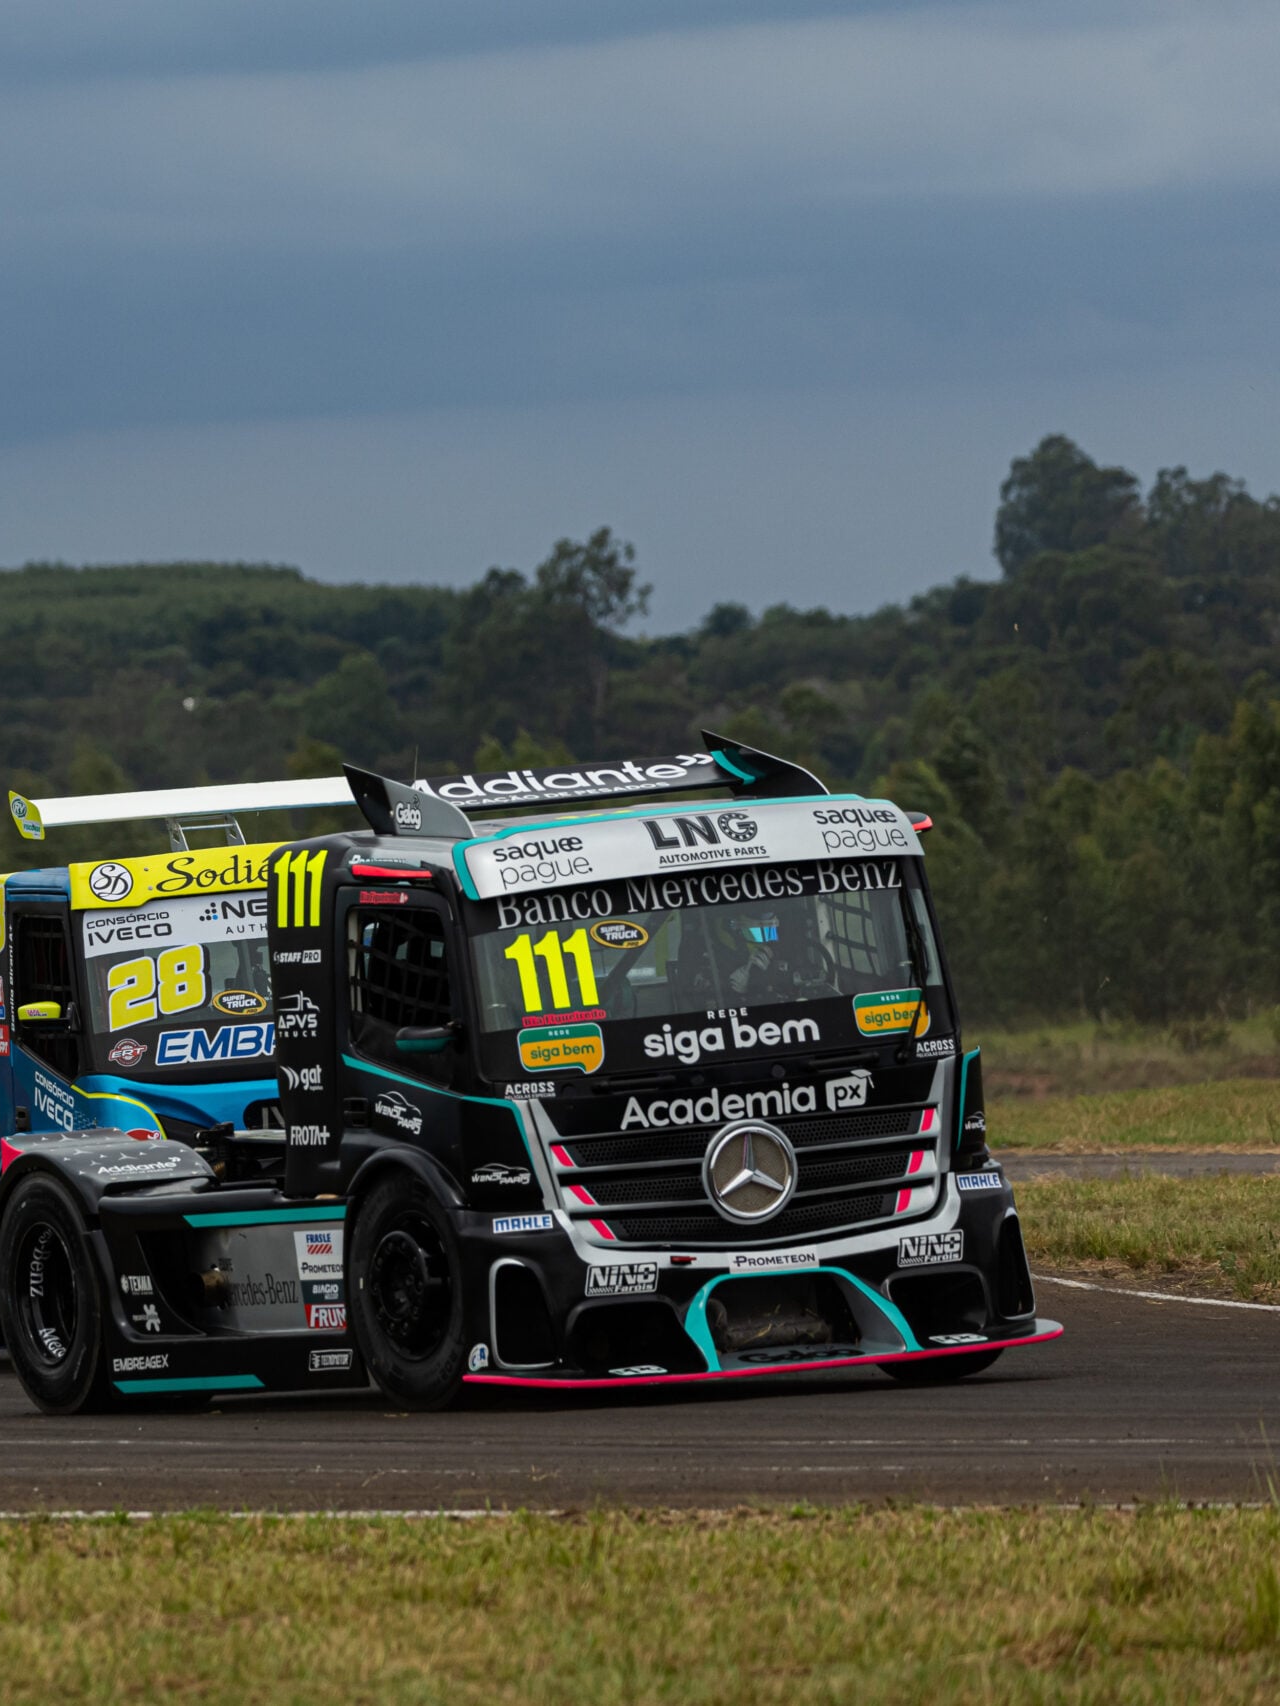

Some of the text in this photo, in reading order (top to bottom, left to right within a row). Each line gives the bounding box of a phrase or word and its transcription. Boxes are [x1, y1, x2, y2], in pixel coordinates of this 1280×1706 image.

[642, 812, 758, 851] LNG
[658, 845, 768, 865] AUTOMOTIVE PARTS
[273, 849, 329, 928] 111
[496, 858, 903, 931] Banco Mercedes-Benz
[85, 910, 170, 930] CONSÓRCIO
[87, 922, 173, 946] IVECO
[605, 930, 639, 941] TRUCK
[504, 928, 600, 1013] 111
[107, 943, 206, 1033] 28
[221, 993, 246, 1003] SUPER
[226, 998, 258, 1009] TRUCK
[707, 1006, 749, 1020] REDE
[277, 1013, 318, 1029] APVS
[863, 1008, 891, 1028] siga
[278, 1030, 317, 1038] TRUCK
[643, 1016, 821, 1065] siga bem
[530, 1043, 595, 1062] siga bem
[915, 1038, 955, 1054] ACROSS
[504, 1081, 556, 1096] ACROSS
[33, 1087, 74, 1132] IVECO
[620, 1081, 862, 1131] Academia px
[958, 1173, 1001, 1190] MAHLE
[494, 1214, 552, 1232] MAHLE
[733, 1252, 816, 1268] PROMETEON
[112, 1353, 169, 1373] EMBREAGEX
